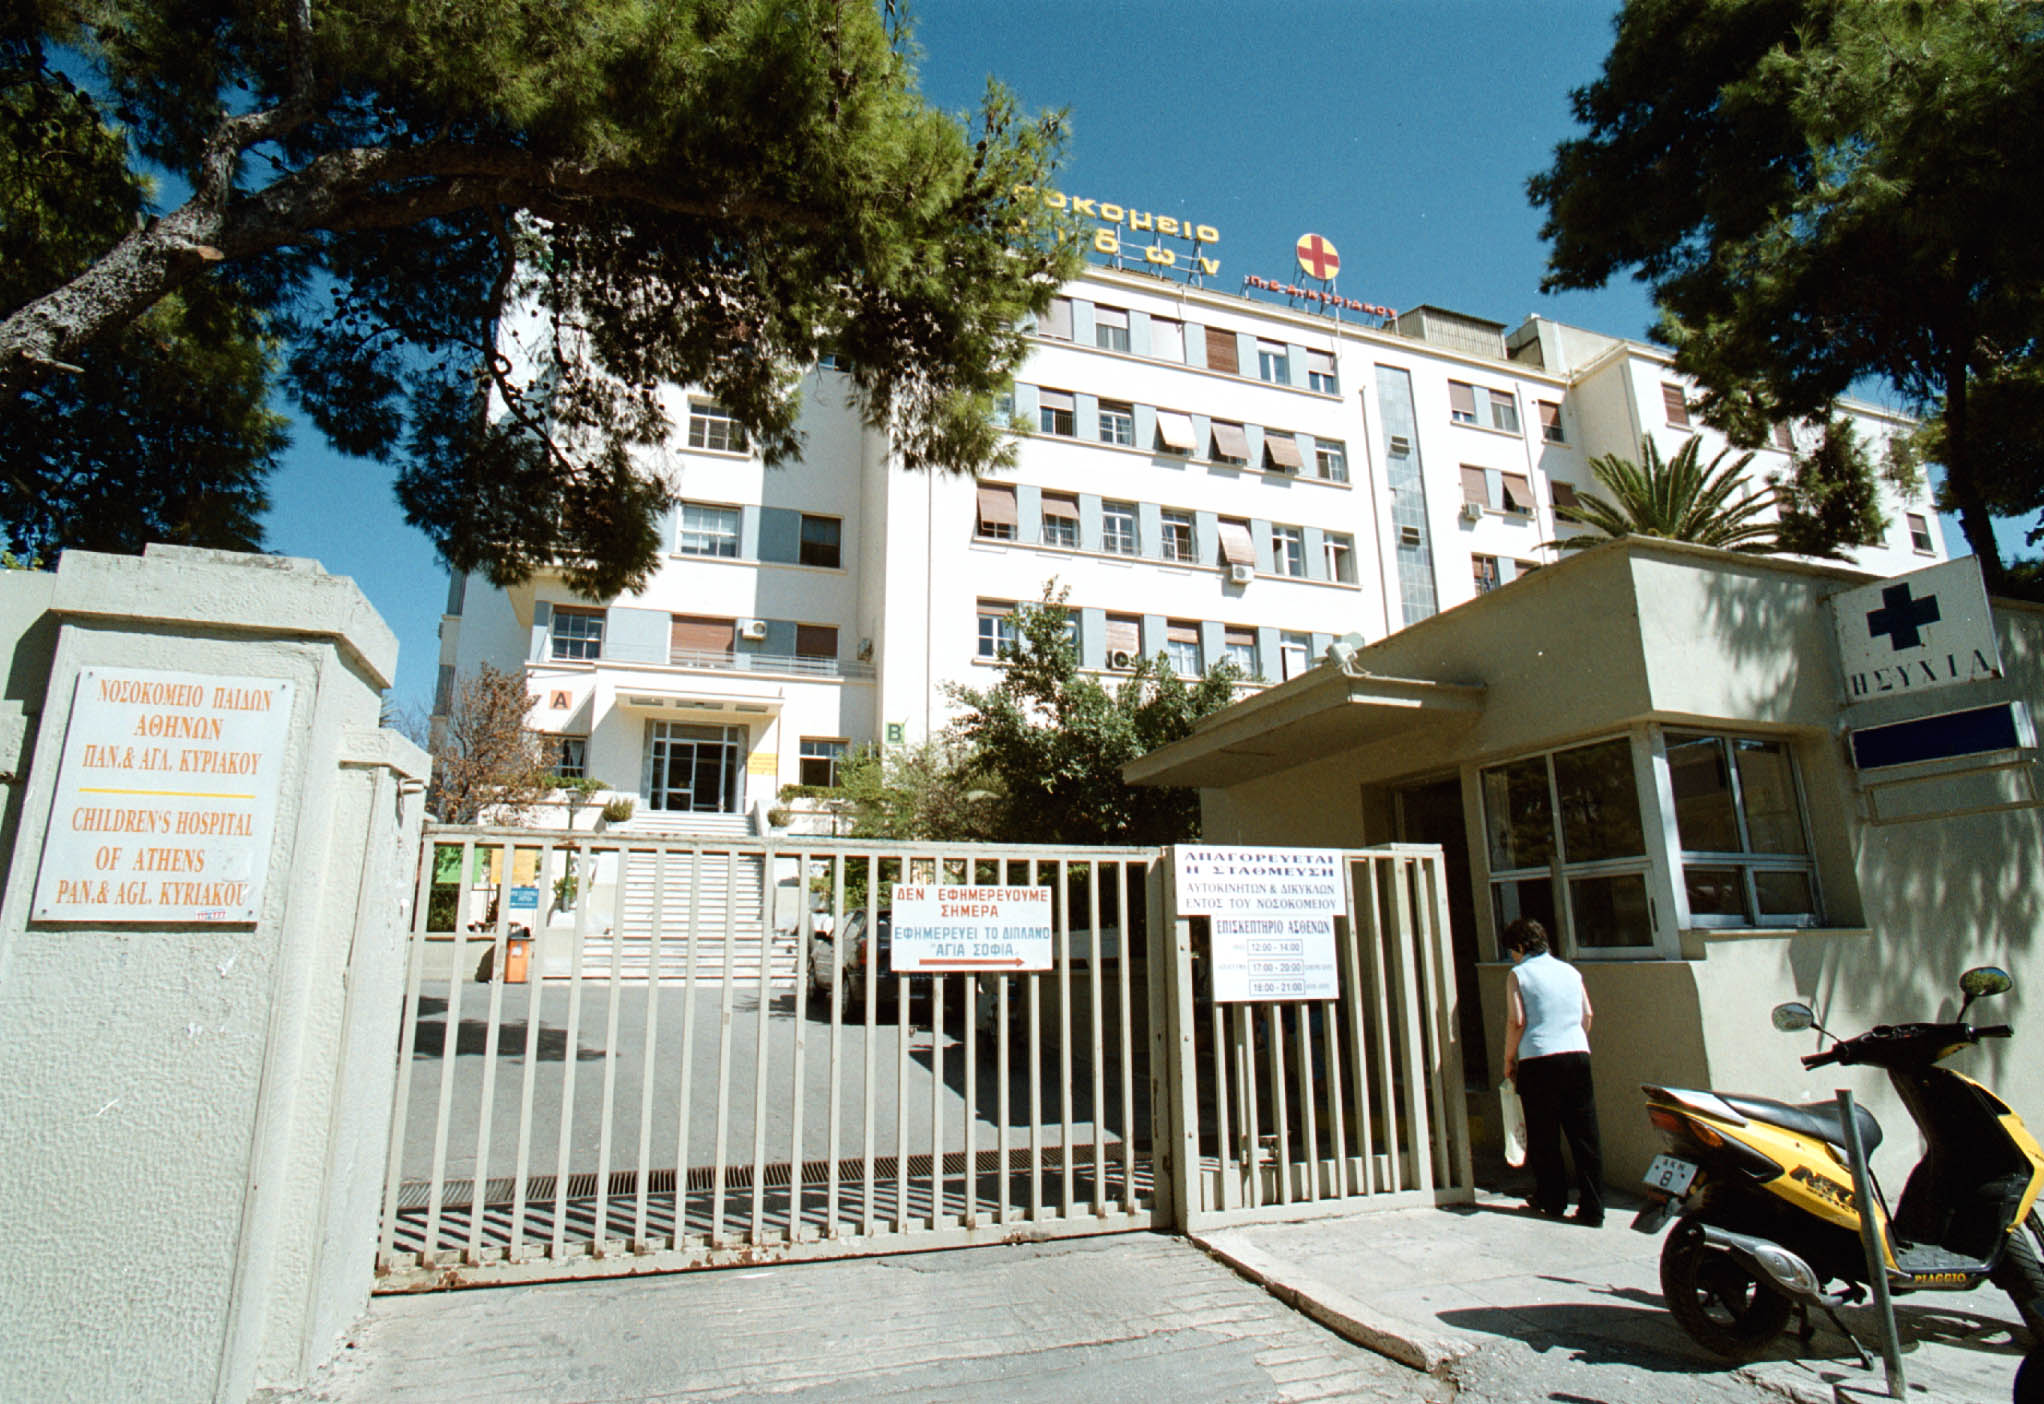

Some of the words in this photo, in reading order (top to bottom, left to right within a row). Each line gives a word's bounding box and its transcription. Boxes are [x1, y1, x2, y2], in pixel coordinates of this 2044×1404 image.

[97, 679, 203, 708] ΝΟΣΟΚΟΜΕΙΟ
[212, 687, 273, 712] ΠΑΙΔΩΝ
[133, 714, 224, 741] ΑΘΗΝΩΝ
[179, 749, 262, 775] ΚΥΡΙΑΚΟΥ
[72, 807, 172, 834] CHILDREN'S
[175, 811, 253, 836] HOSPITAL
[95, 846, 123, 871] OF
[132, 848, 205, 873] ATHENS
[1185, 852, 1334, 864] ΑΠΑΓΟΡΕΥΕΤΑΙ
[1186, 865, 1199, 875] Η
[1213, 866, 1334, 877] ΣΤΑΘΜΕΥΣΗ
[114, 881, 152, 905] AGL.
[159, 882, 249, 907] KYRIAKOU
[897, 888, 925, 901] ΔΕΝ
[938, 888, 1049, 902] ΕΦΗΜΕΡΕΥΟΥΜΕ
[1187, 883, 1267, 894] ΑΥΤΟΚΙΝΗΤΩΝ
[1270, 884, 1277, 894] &
[1281, 884, 1335, 895] ΔΙΚΥΚΛΩΝ
[941, 904, 999, 918] ΣΗΜΕΡΑ
[1186, 898, 1223, 909] ΕΝΤΟΣ
[1230, 898, 1251, 909] ΤΟΥ
[1256, 899, 1337, 910] ΝΟΣΟΚΟΜΕΙΟΥ
[894, 927, 978, 940] ΕΦΗΜΕΡΕΥΕΙ
[985, 927, 998, 940] ΤΟ
[1002, 927, 1050, 940] ΔΙΠΛΑΝΟ
[1914, 1272, 1968, 1283] PIAGGIO
